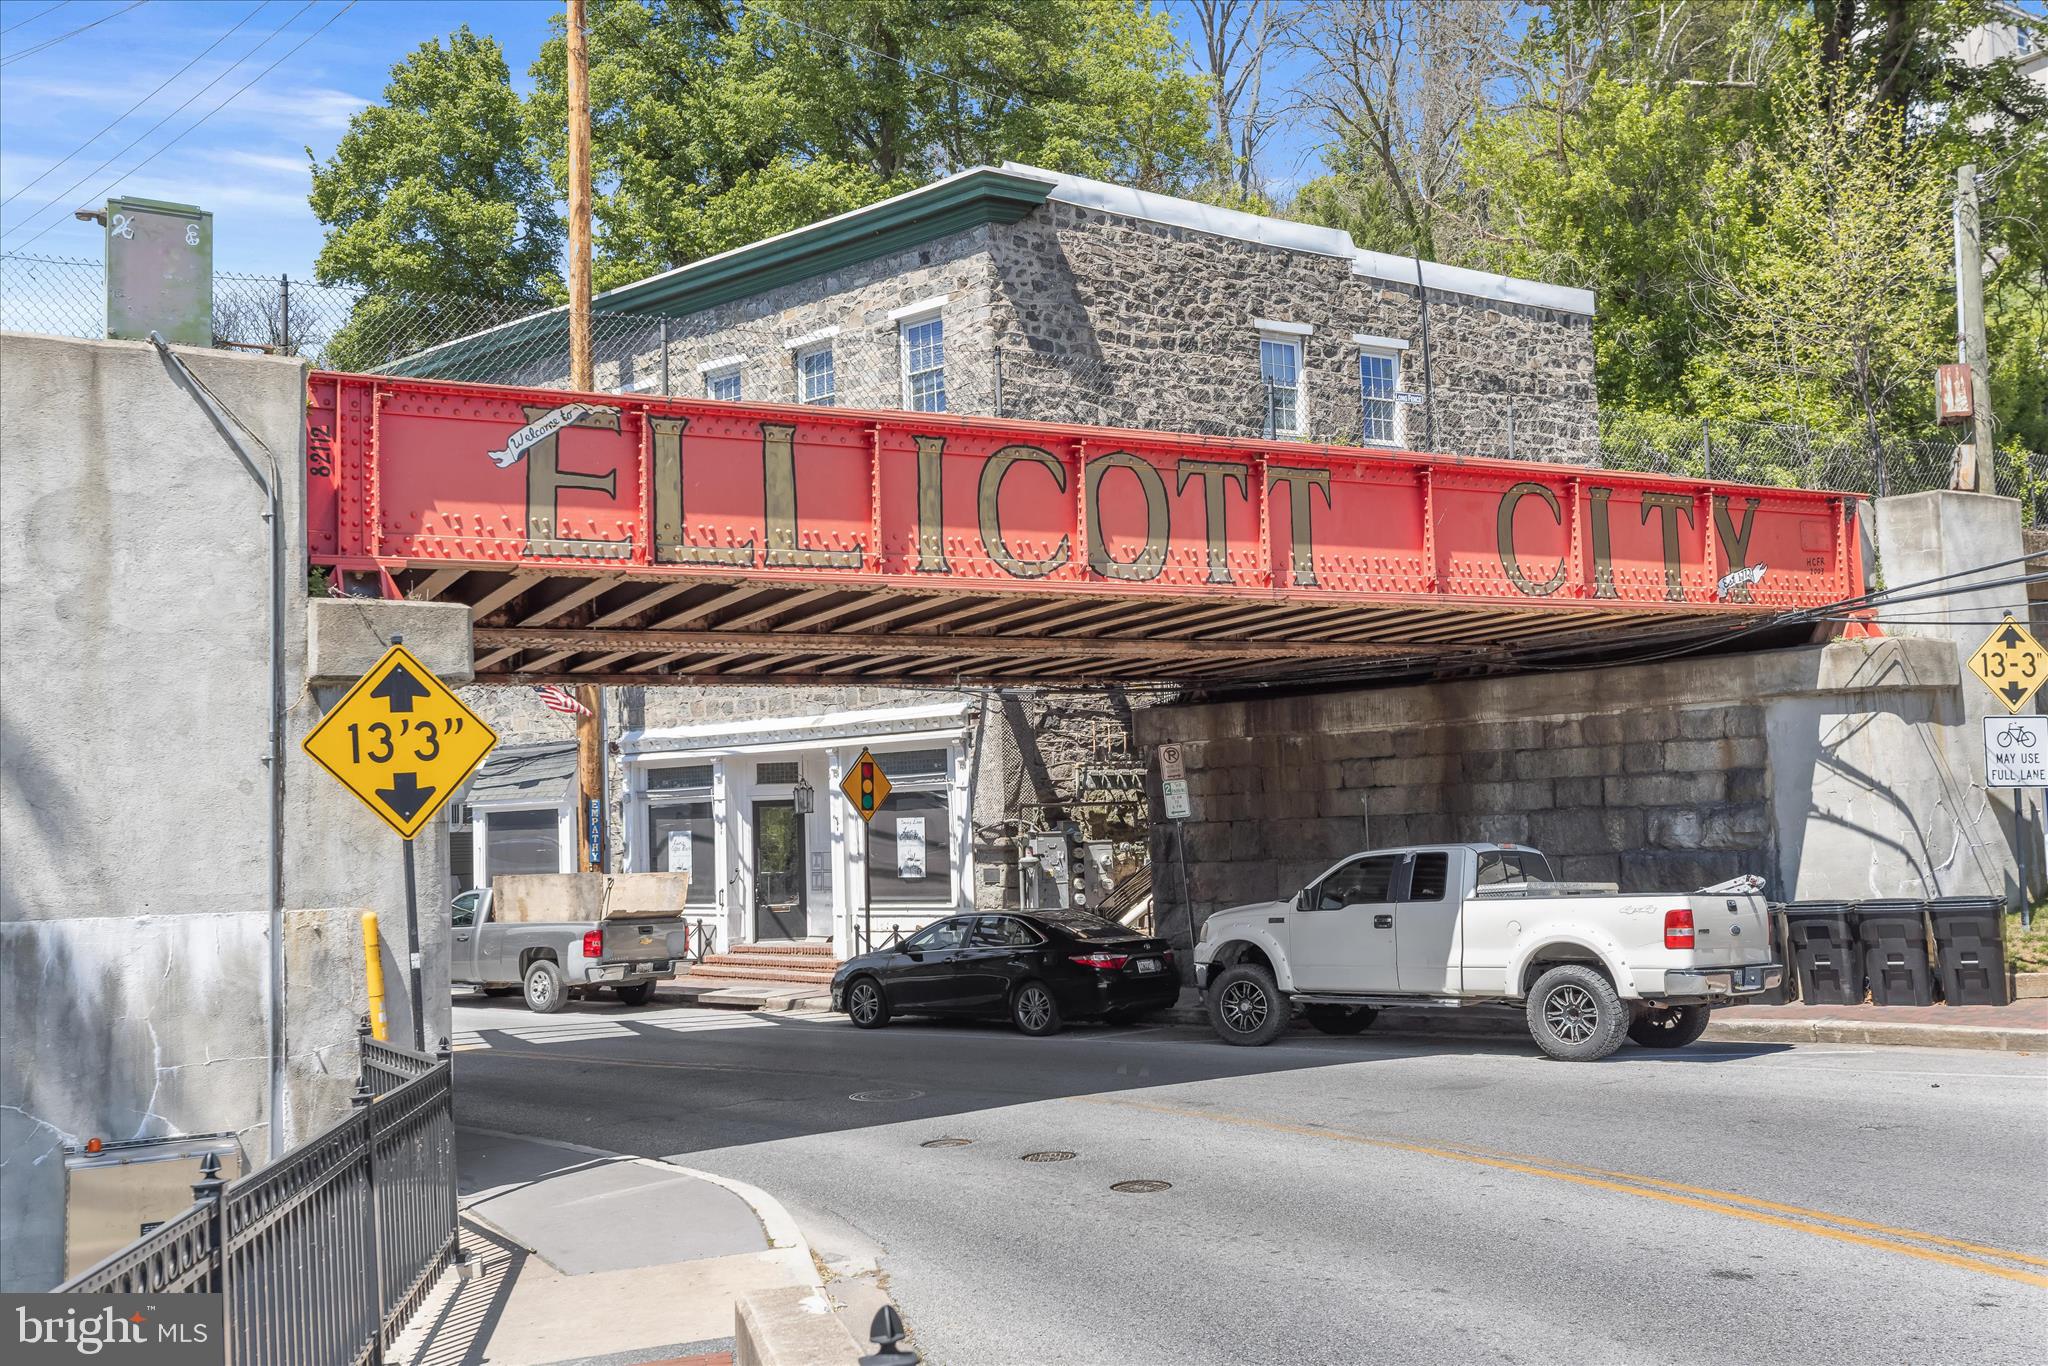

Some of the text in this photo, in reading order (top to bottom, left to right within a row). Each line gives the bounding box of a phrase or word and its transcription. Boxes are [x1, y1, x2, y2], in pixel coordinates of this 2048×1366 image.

[510, 409, 573, 449] Welcome to
[520, 405, 1761, 604] ELLICOTT CITY
[1991, 769, 2046, 780] FULL LANE
[1996, 753, 2040, 764] MAY USE
[591, 800, 599, 861] EMPATHY
